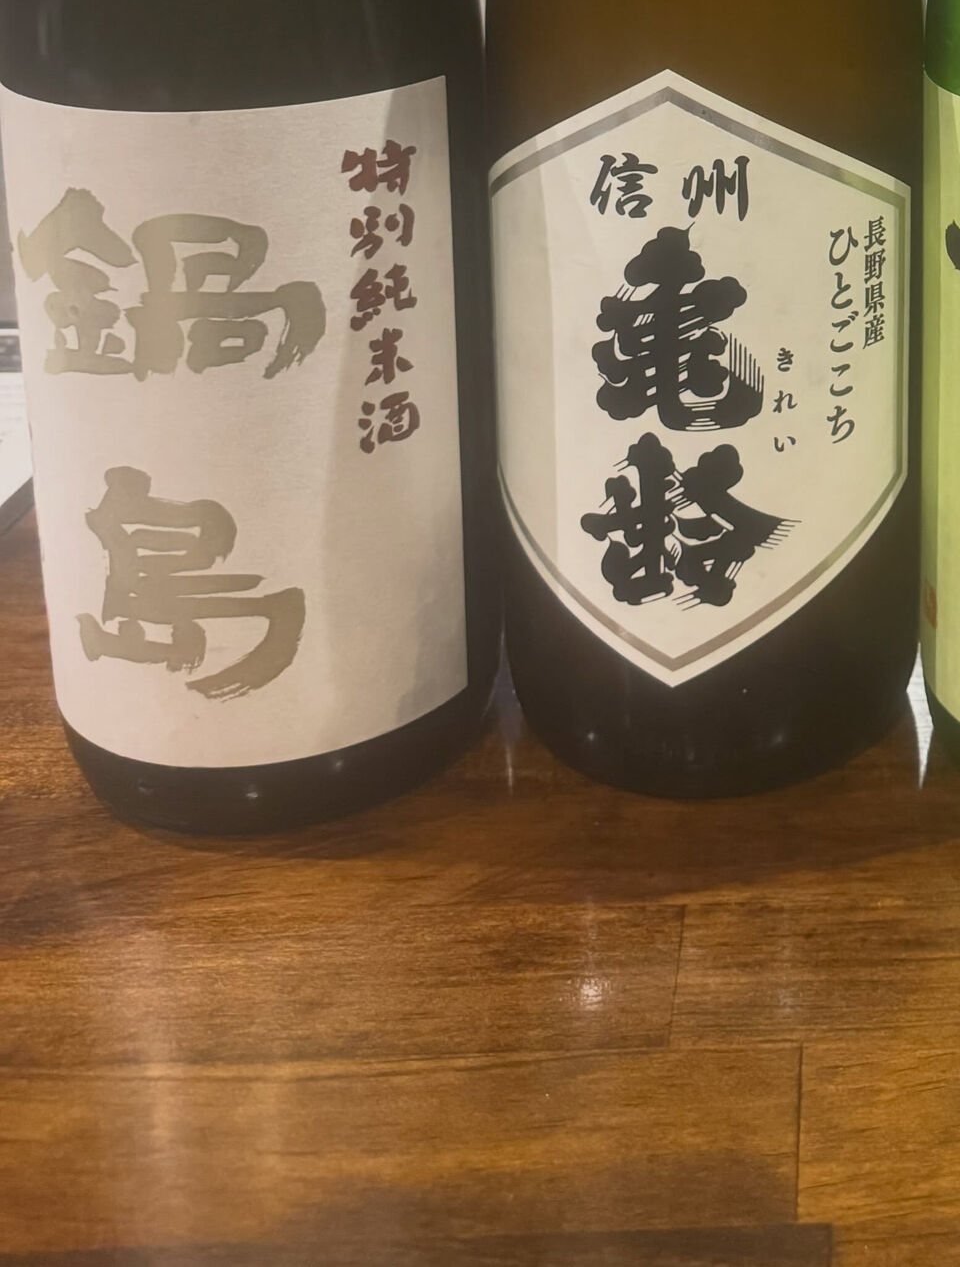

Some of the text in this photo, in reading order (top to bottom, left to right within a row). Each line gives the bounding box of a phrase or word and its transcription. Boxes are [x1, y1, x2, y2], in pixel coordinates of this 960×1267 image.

[590, 152, 751, 222] 信州
[341, 138, 421, 455] 特別純米酒
[826, 225, 860, 444] ひとごこち
[862, 215, 887, 350] 長野県産
[19, 186, 327, 702] 鍋島
[772, 347, 798, 452] きれい
